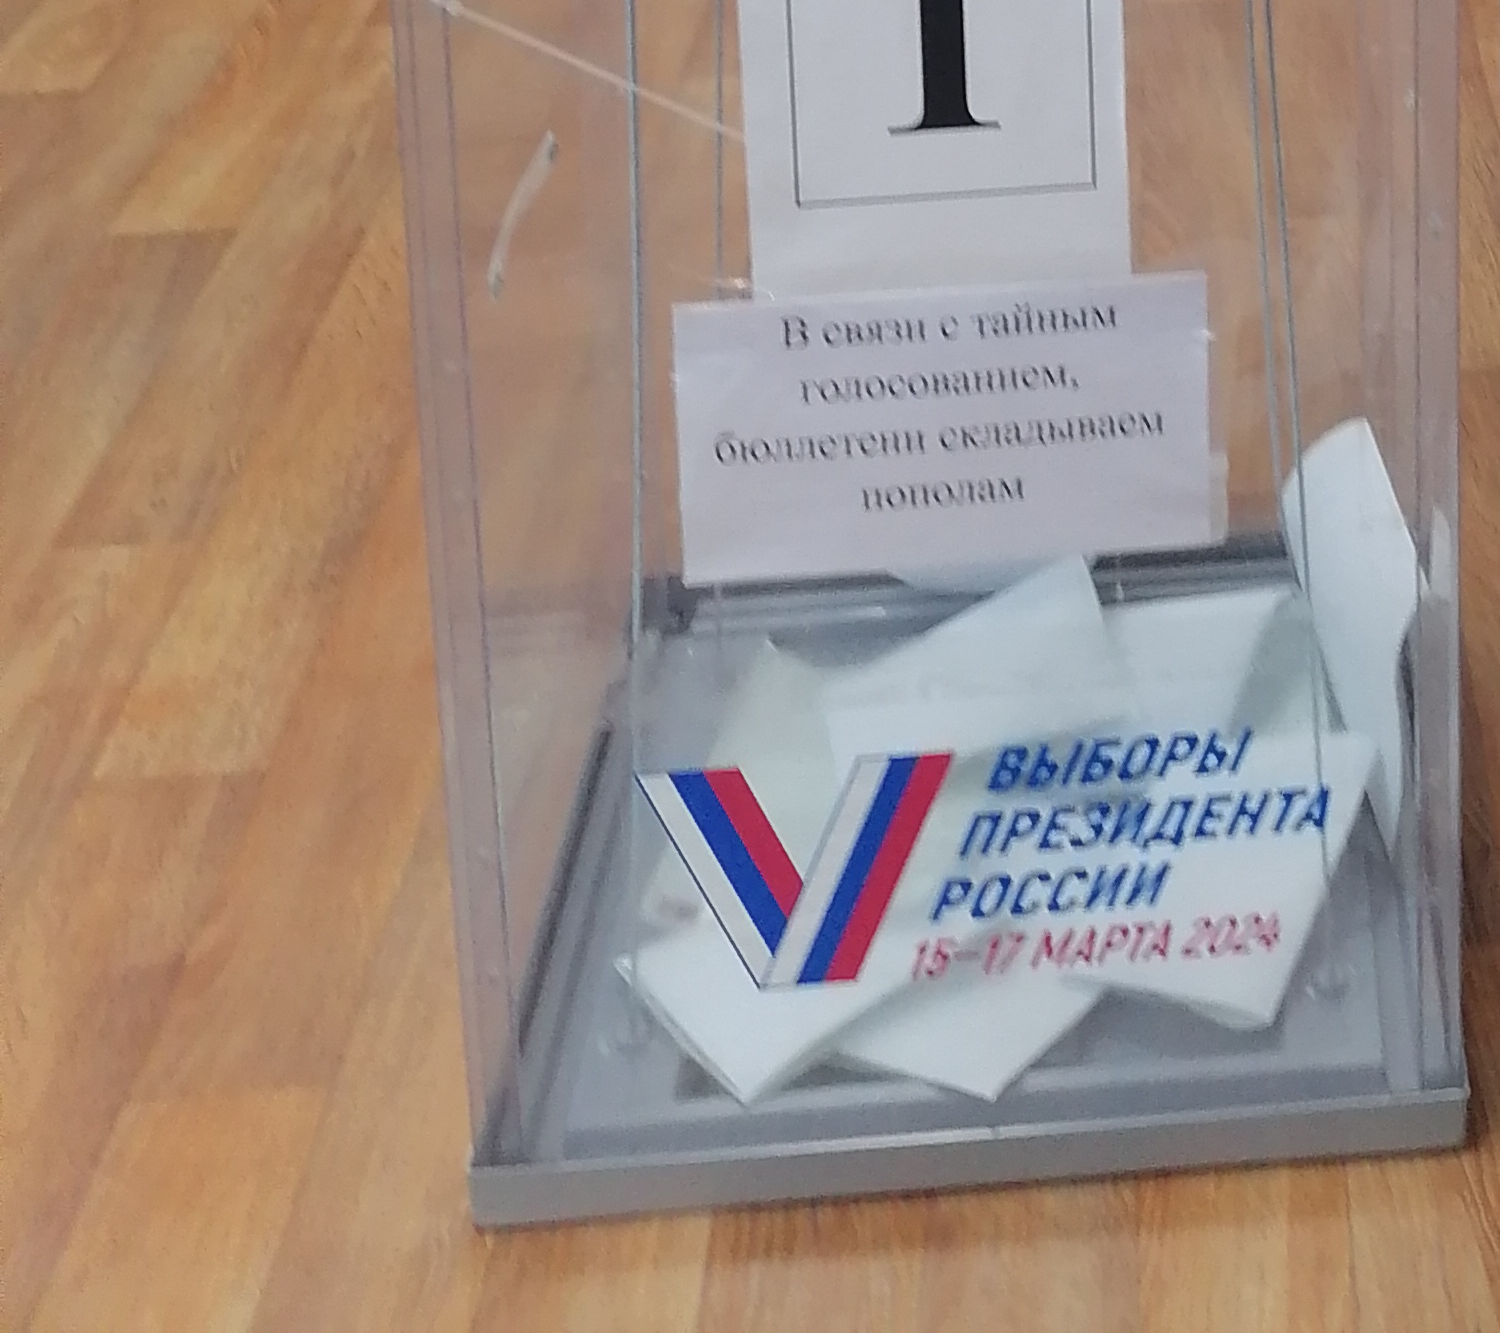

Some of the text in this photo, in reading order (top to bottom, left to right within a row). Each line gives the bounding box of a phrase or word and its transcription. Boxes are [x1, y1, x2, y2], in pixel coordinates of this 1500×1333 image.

[780, 301, 1117, 350] В связи с тайным
[800, 362, 1079, 406] голосованием,
[715, 410, 1163, 467] бюллетени складываем
[861, 477, 1025, 513] пополам
[987, 725, 1253, 792] ВЫБОРЫ
[959, 783, 1331, 861] ПРЕЗИДЕНТА
[929, 860, 1172, 922] РОССИИ
[911, 910, 1281, 981] 15-17 МАРТА 2024
